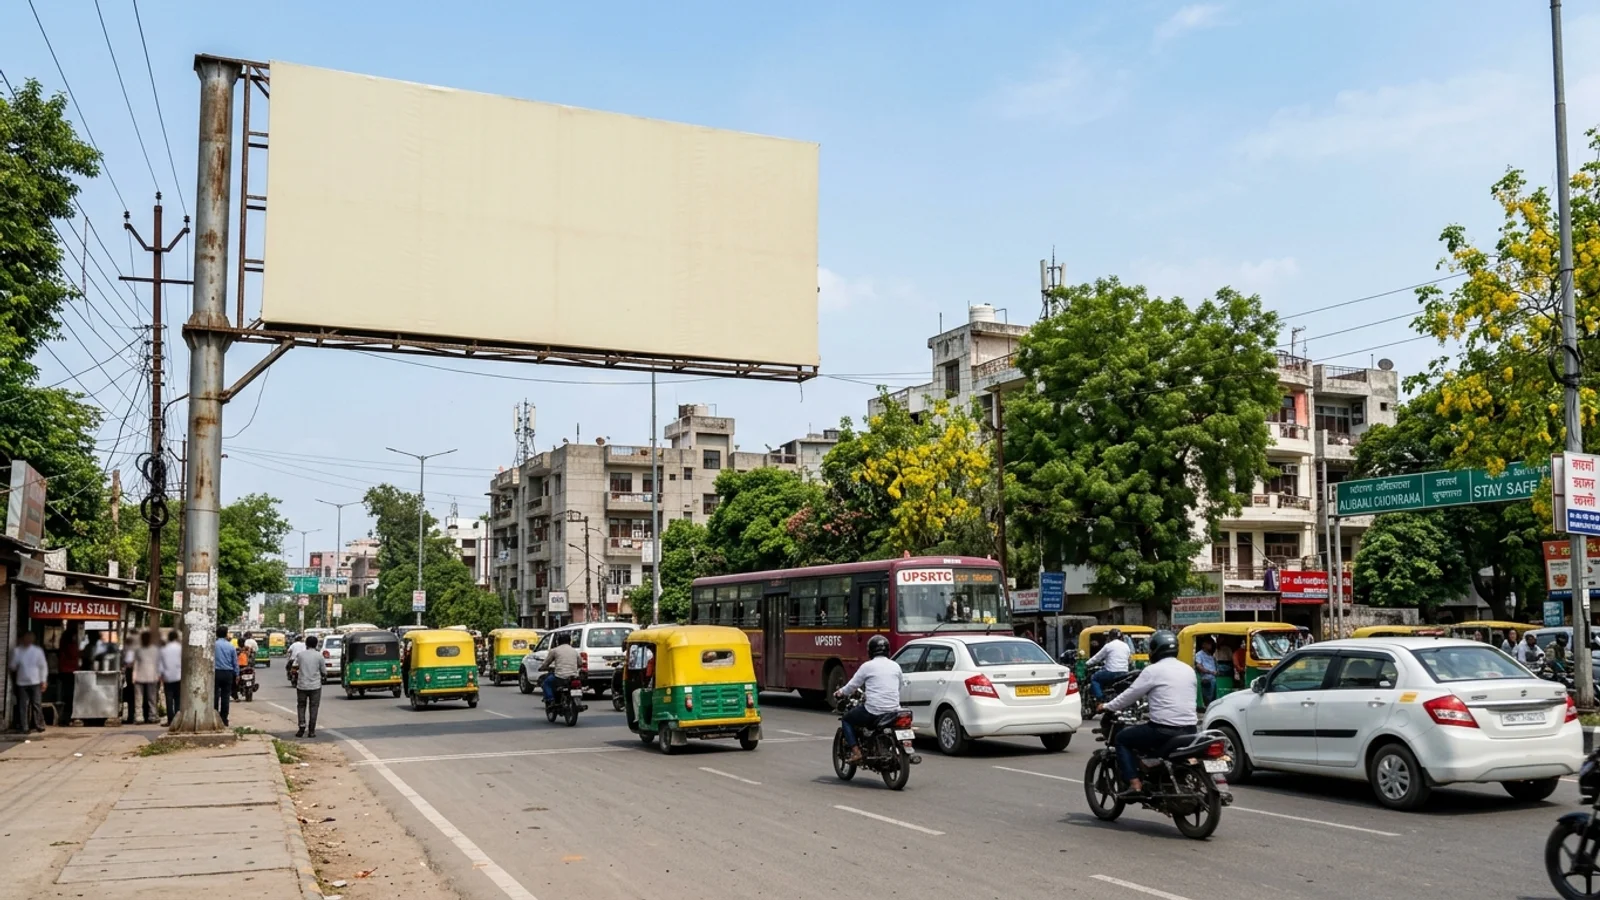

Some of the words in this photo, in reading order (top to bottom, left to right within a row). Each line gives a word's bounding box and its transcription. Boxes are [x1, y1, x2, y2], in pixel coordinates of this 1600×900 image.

[1474, 483, 1502, 498] STAY
[1506, 480, 1538, 495] SAFE
[902, 571, 952, 582] UPSRTC
[33, 601, 62, 614] RAJU
[64, 602, 84, 614] TEA
[86, 603, 119, 615] STALL
